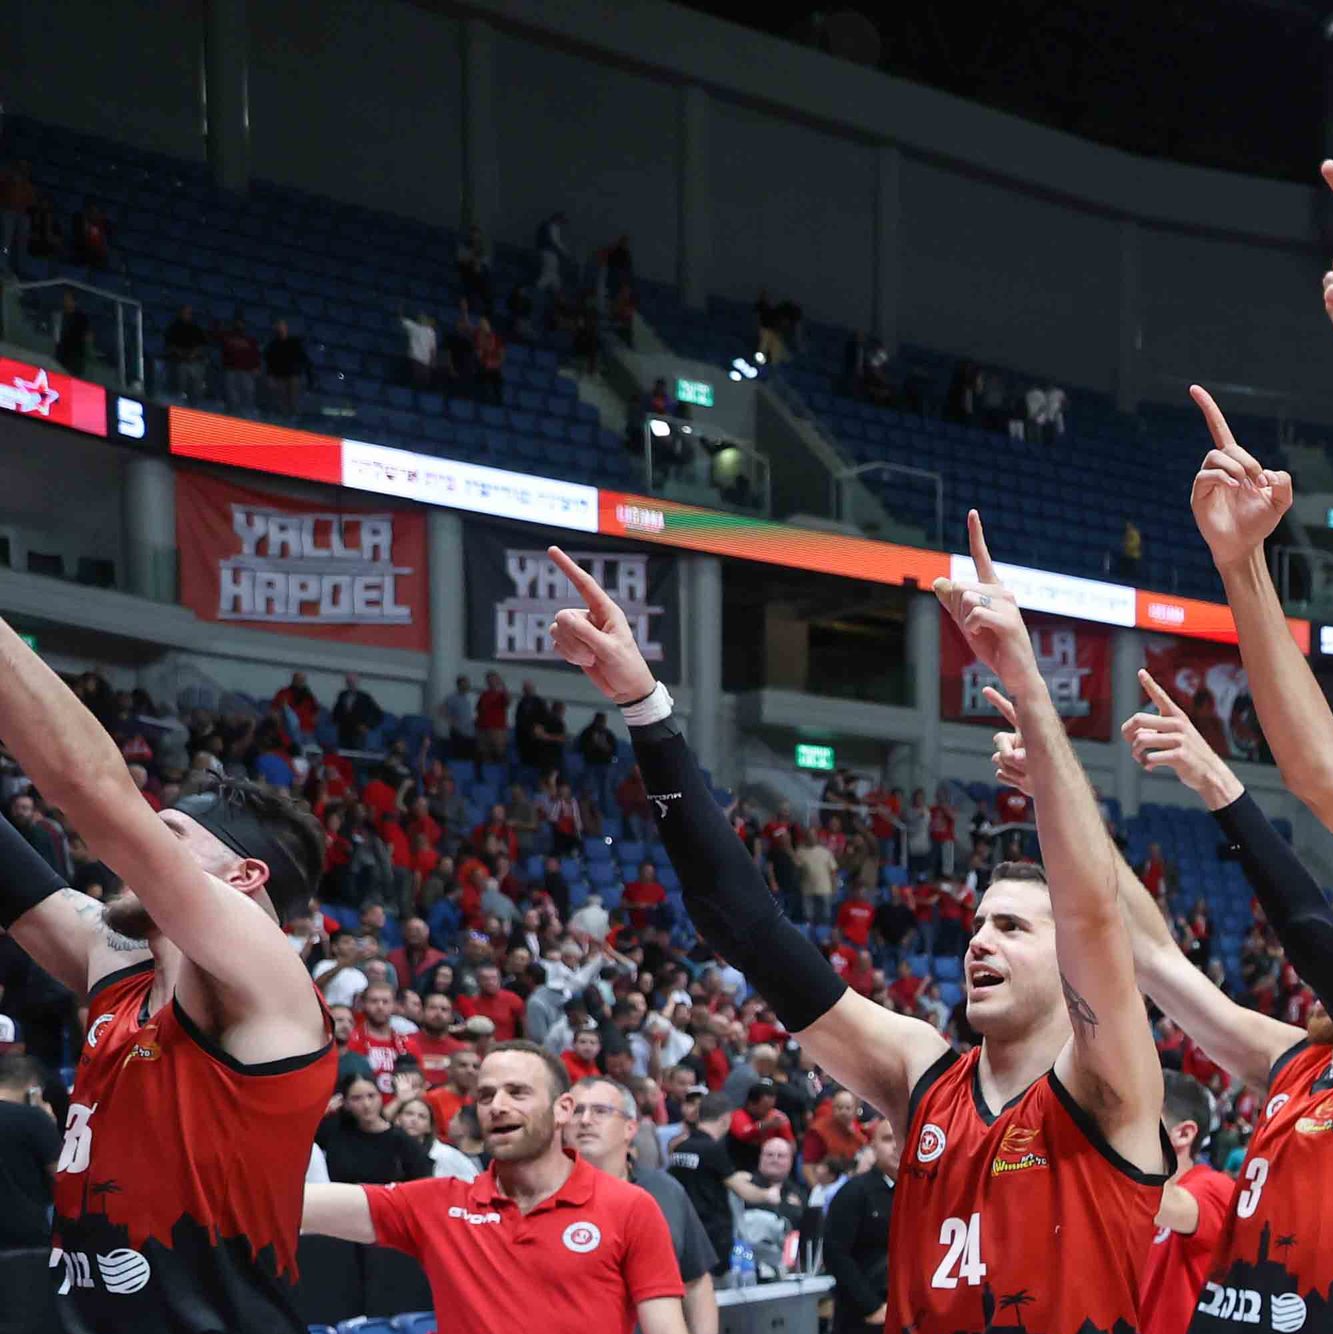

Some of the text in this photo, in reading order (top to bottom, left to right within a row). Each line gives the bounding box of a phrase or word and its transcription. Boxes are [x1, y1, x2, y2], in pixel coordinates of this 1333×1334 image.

[117, 401, 146, 440] 5
[231, 504, 393, 564] YALLA
[218, 569, 411, 624] HAPOEL
[495, 605, 664, 660] HAL
[993, 1158, 1034, 1173] Winner
[1237, 1156, 1269, 1219] 3
[930, 1212, 987, 1291] 24
